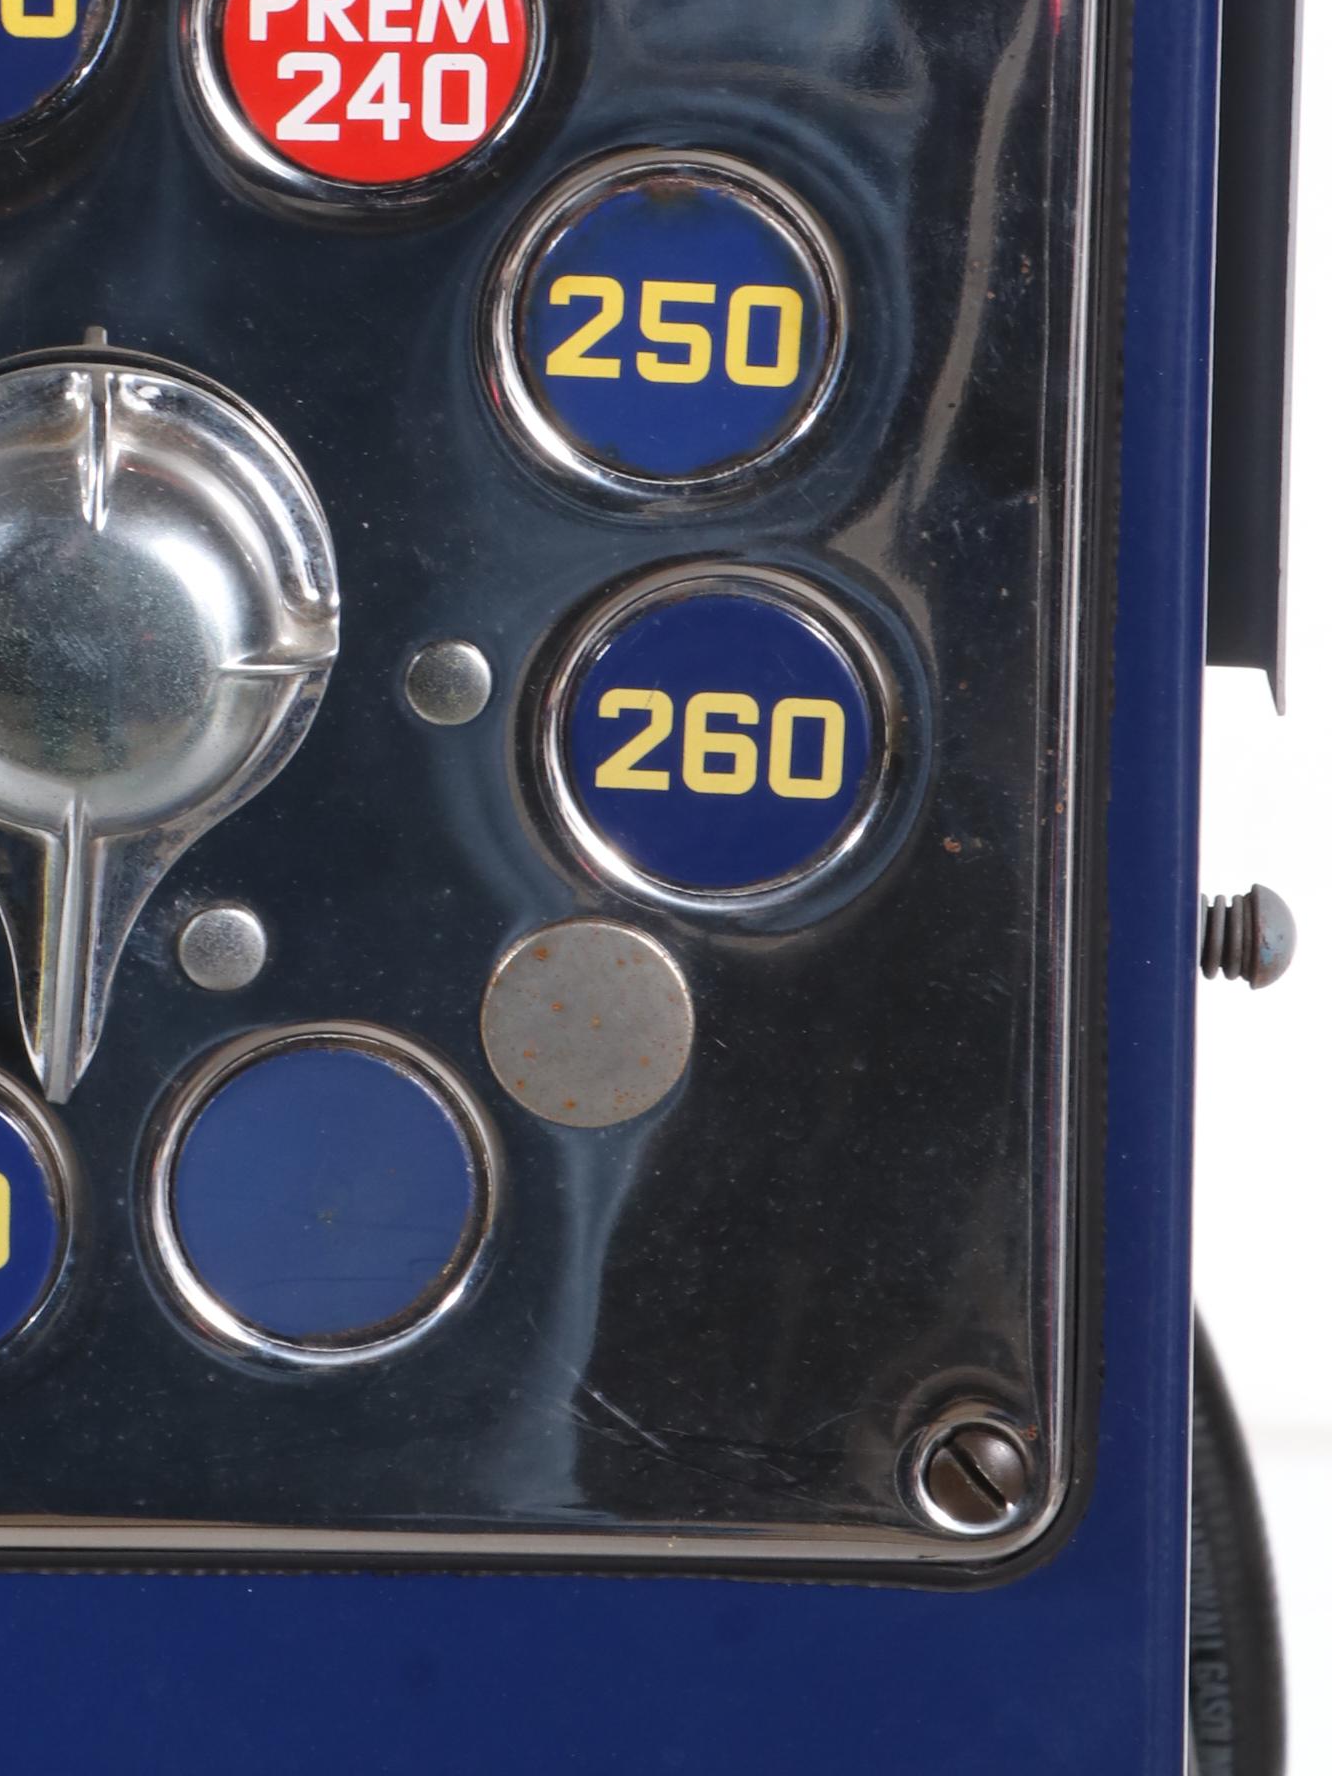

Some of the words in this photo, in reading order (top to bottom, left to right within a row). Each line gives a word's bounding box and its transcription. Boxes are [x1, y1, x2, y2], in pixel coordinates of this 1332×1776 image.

[275, 51, 488, 143] 240
[545, 275, 804, 388] 250
[594, 687, 846, 801] 260
